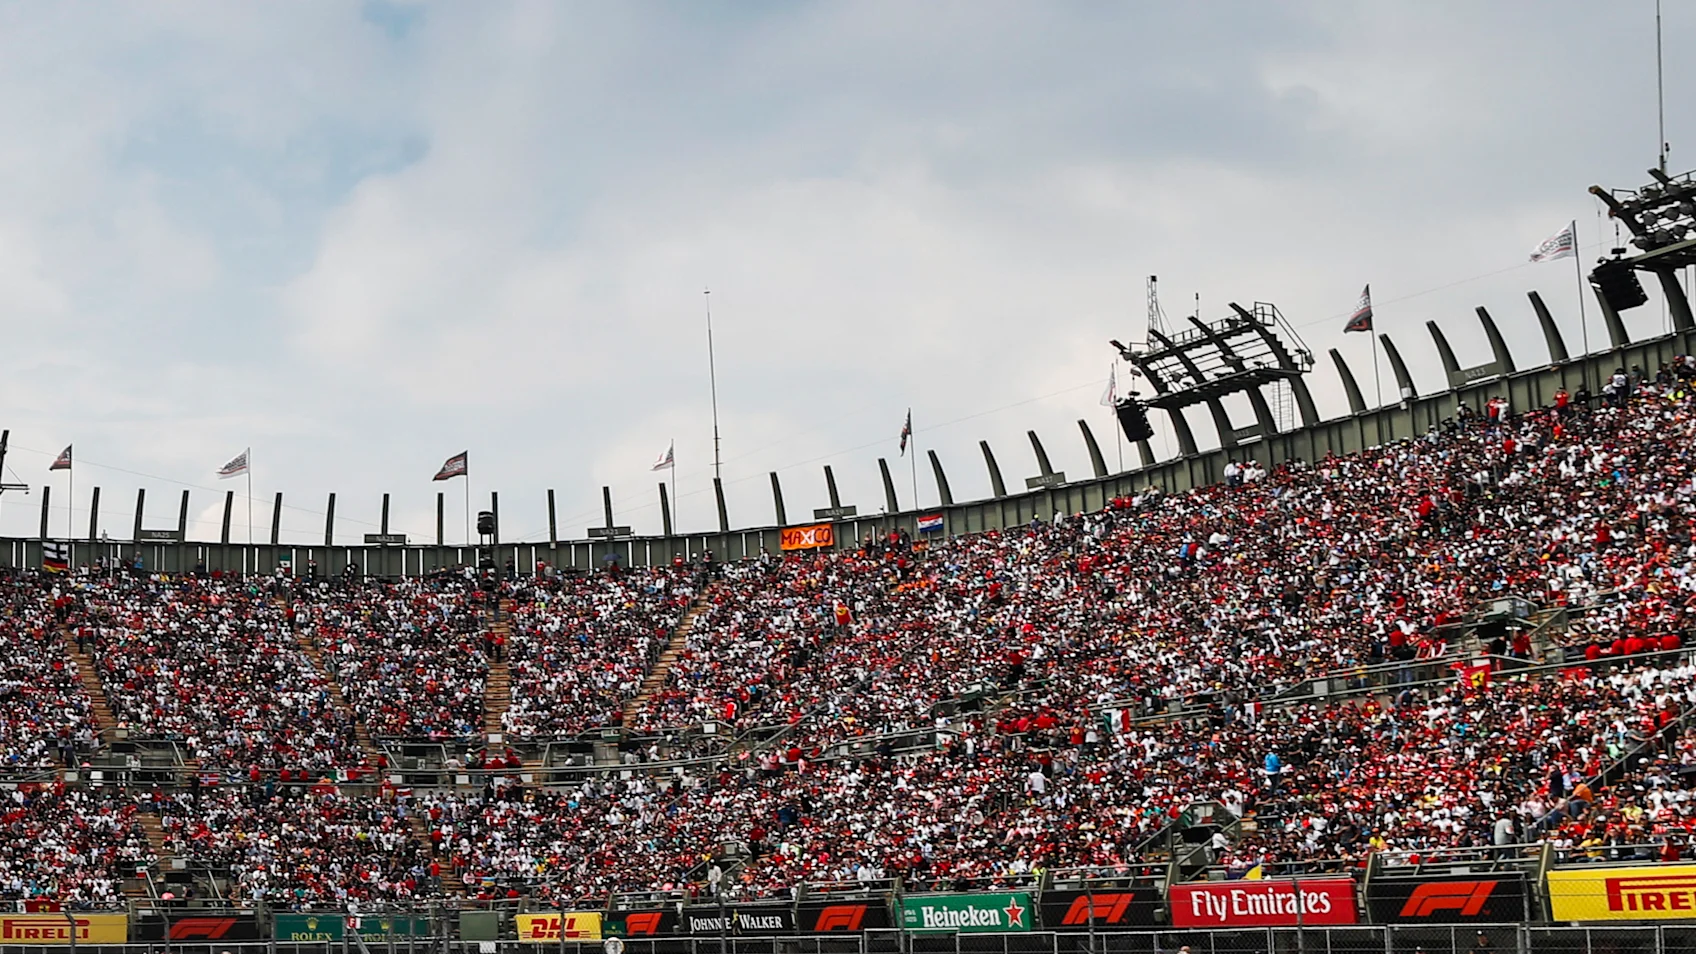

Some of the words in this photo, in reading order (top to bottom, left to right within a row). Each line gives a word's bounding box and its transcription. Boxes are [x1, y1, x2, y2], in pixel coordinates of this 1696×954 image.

[1606, 874, 1696, 912] PIRE
[1191, 891, 1226, 921] Fly
[1233, 888, 1331, 917] Emirates
[689, 916, 732, 934] JOHNNE
[739, 914, 783, 930] WALKER
[922, 905, 1002, 928] Heineken
[2, 919, 90, 939] PIRELLI
[291, 932, 333, 942] ROLEX
[363, 933, 405, 942] ROLX
[531, 918, 581, 938] DHL
